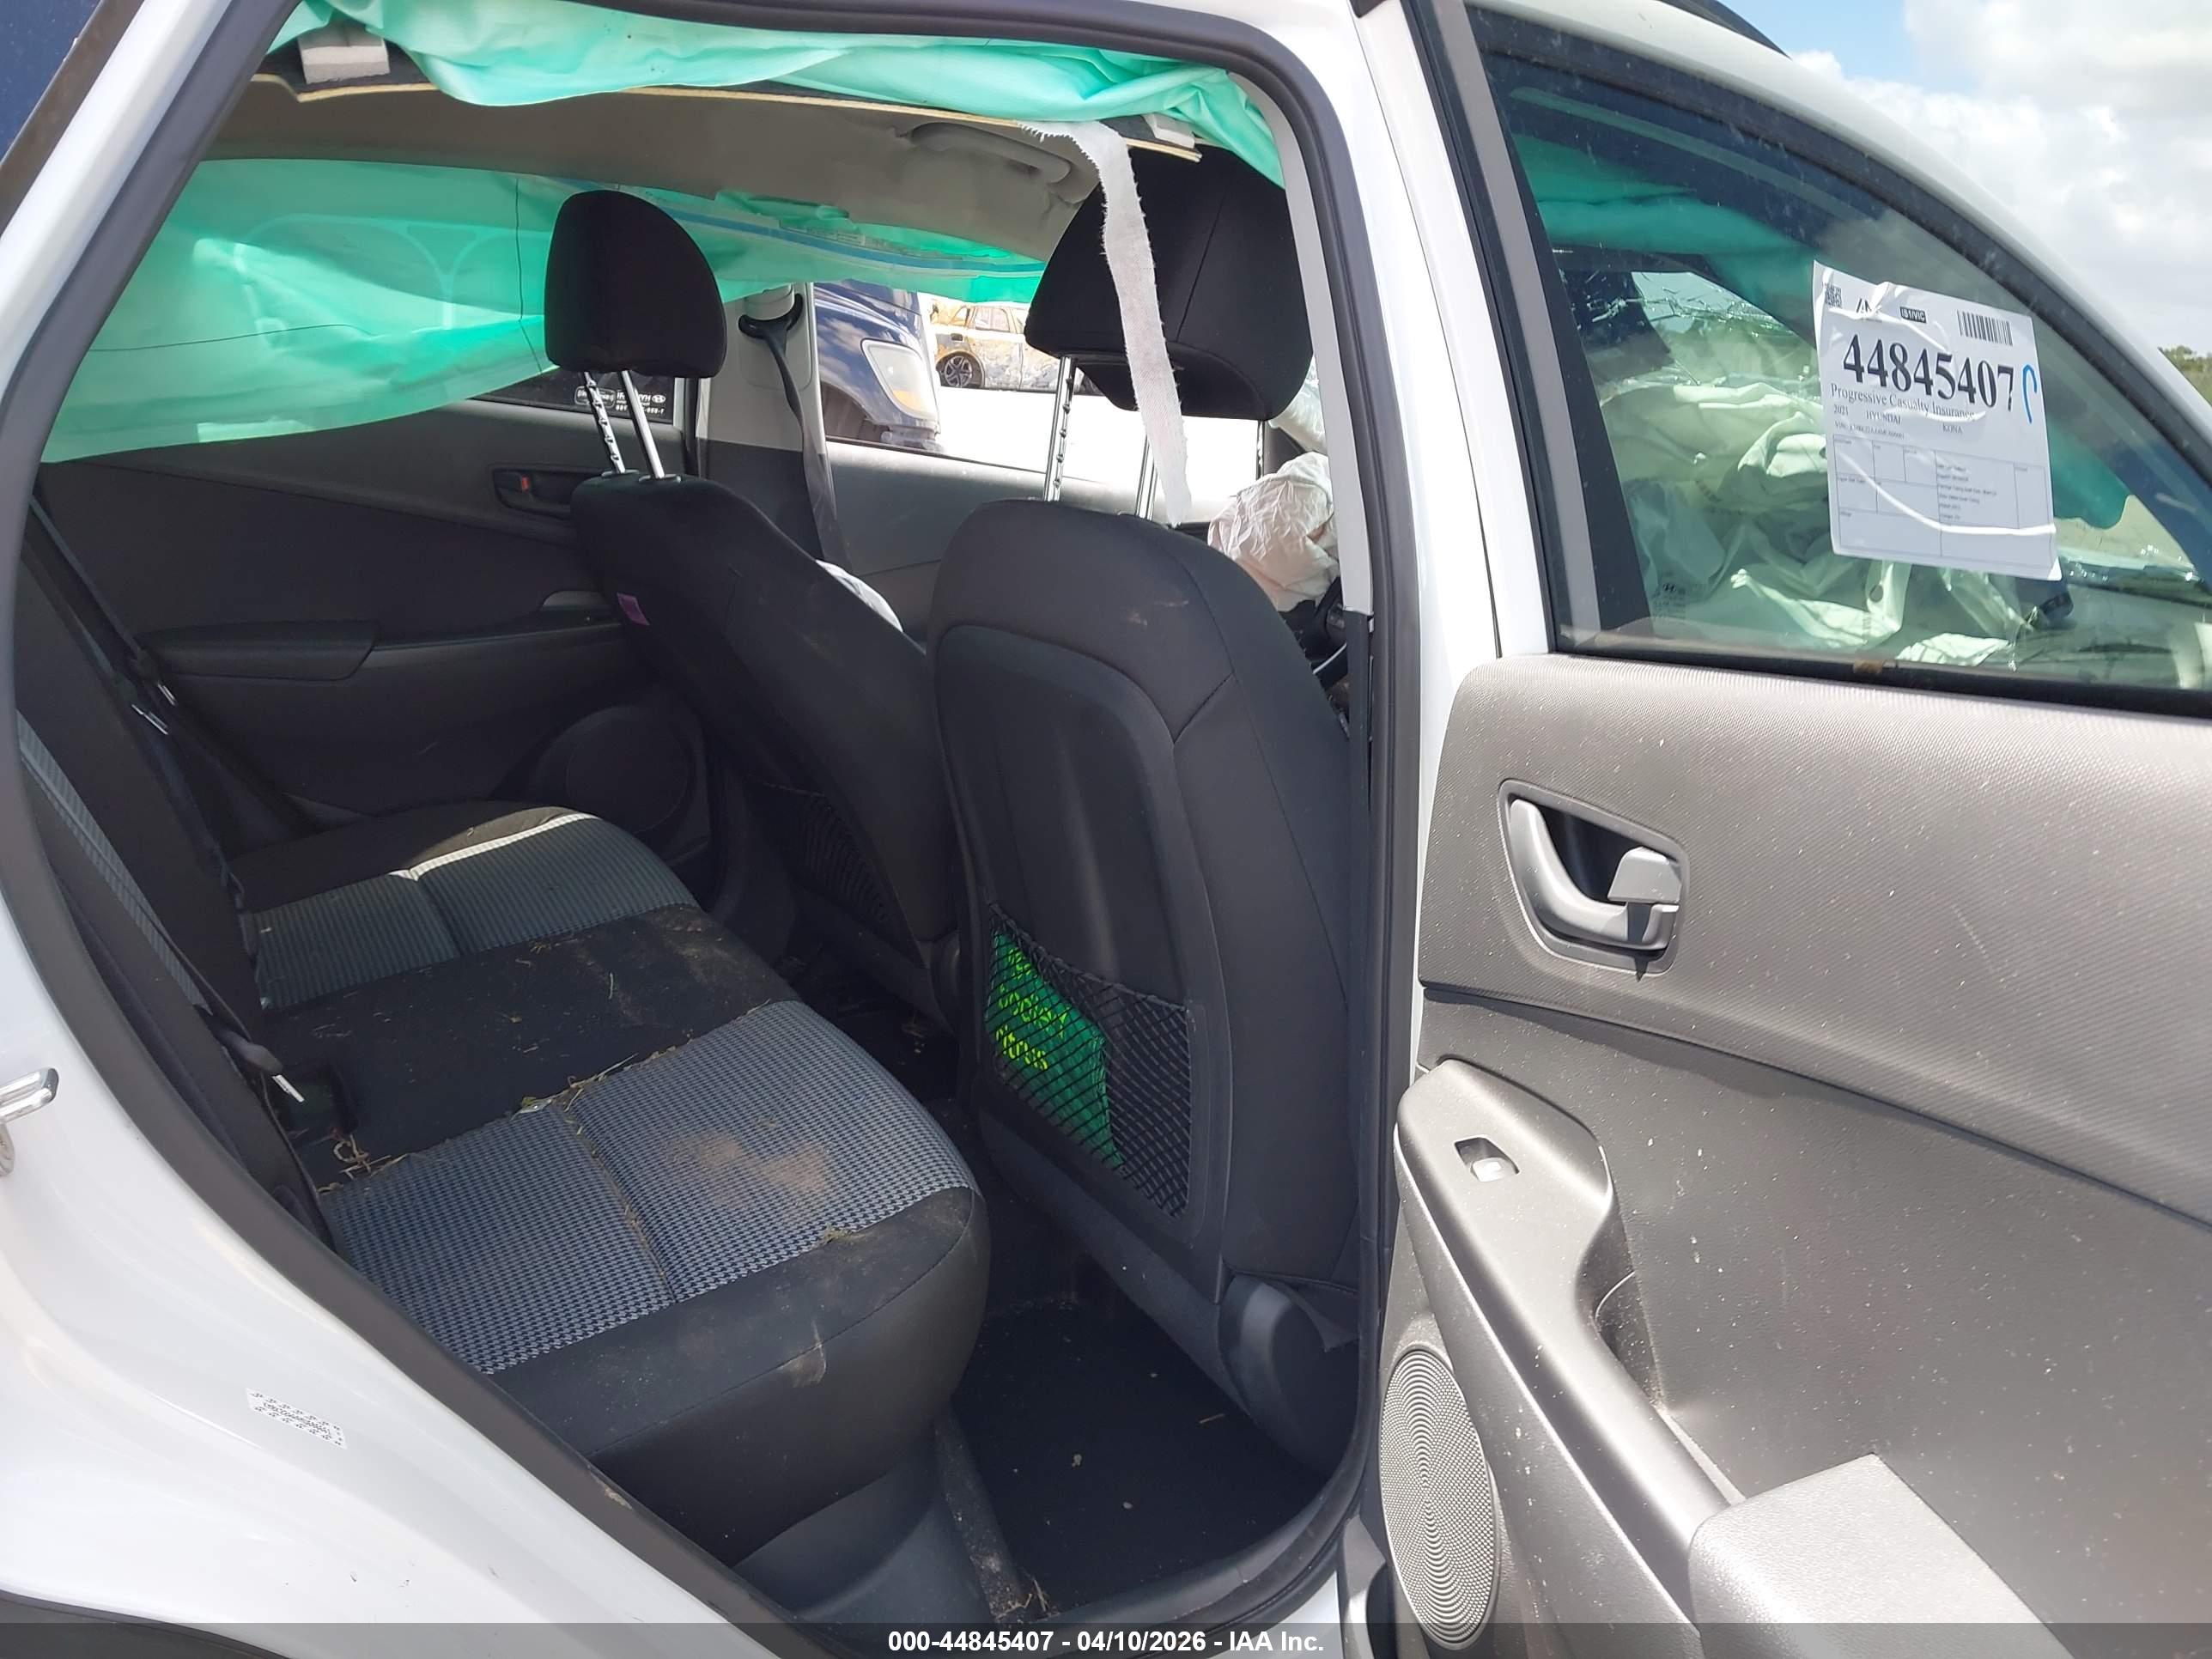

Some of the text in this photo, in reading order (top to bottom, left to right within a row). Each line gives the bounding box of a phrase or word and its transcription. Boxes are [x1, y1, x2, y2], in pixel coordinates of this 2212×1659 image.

[1843, 333, 2014, 412] 44845407
[1831, 383, 1975, 421] Progressive Casualty Insurance
[1866, 411, 1902, 426] HYUNDAI
[1942, 423, 1964, 434] KONA
